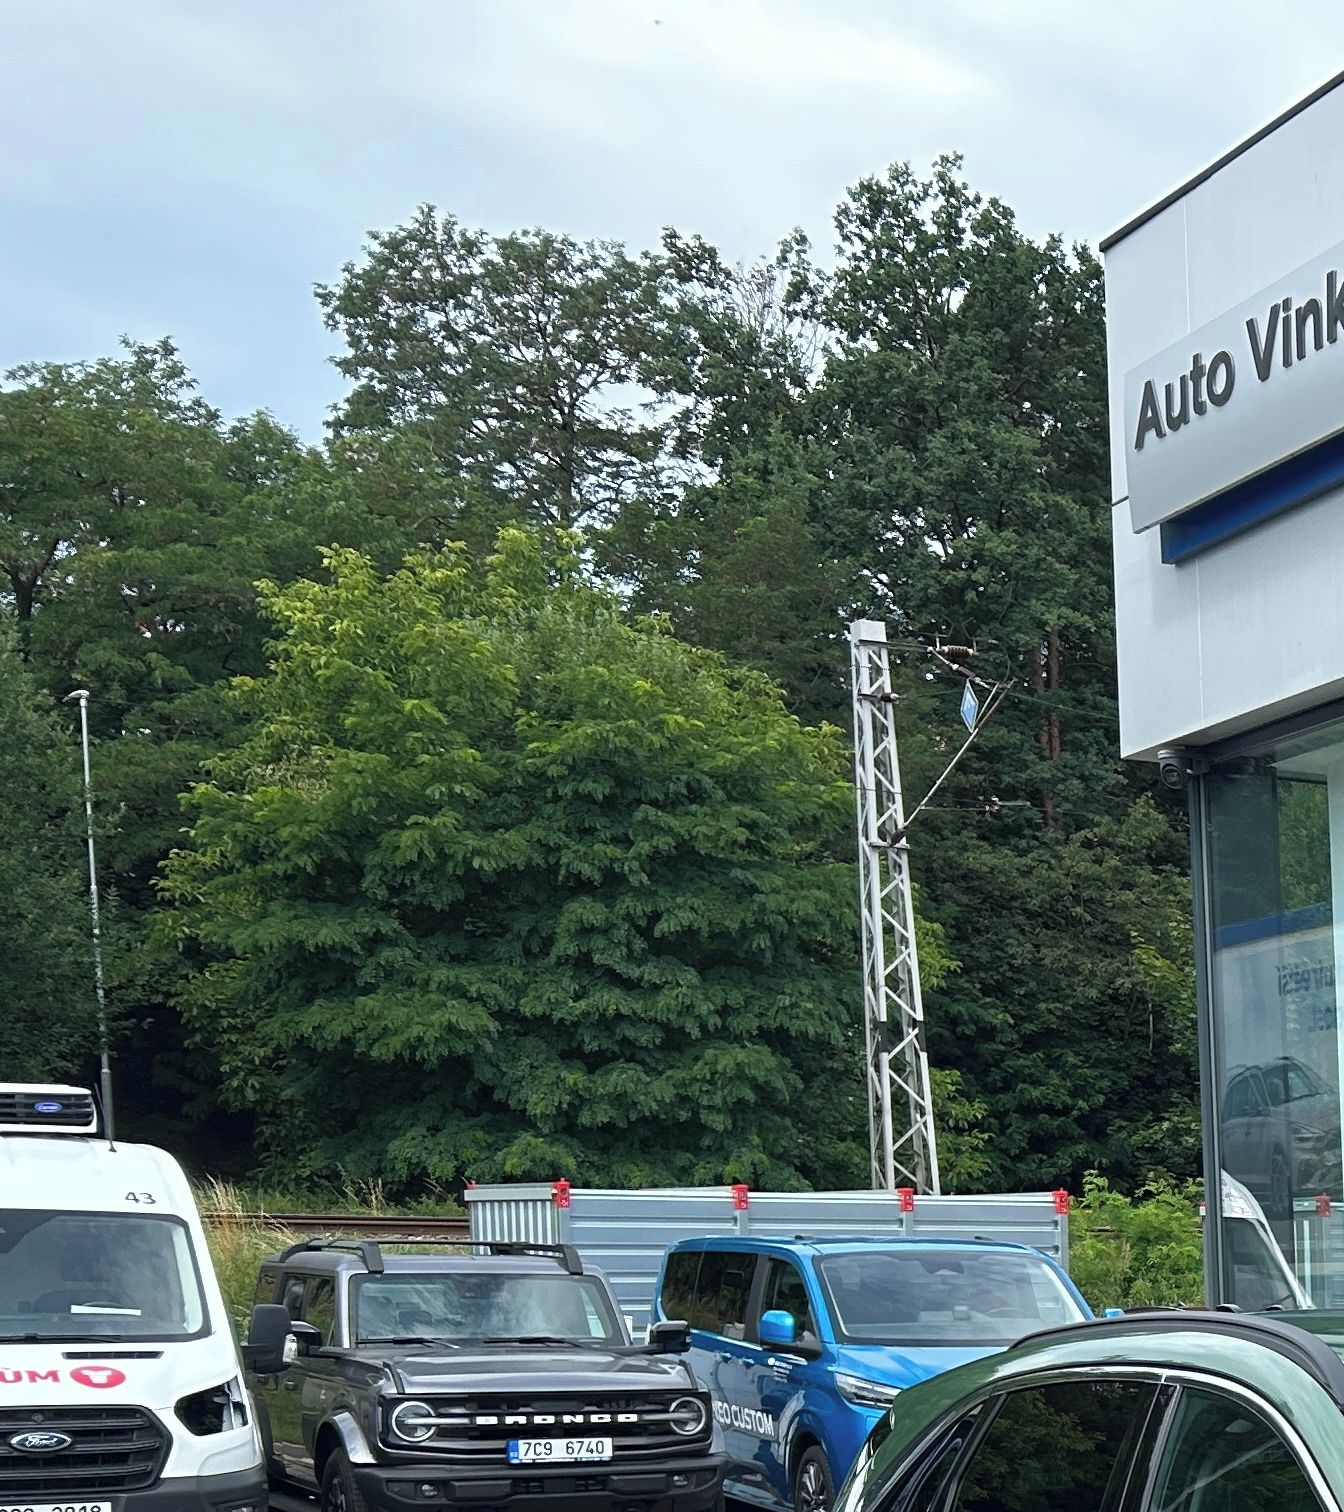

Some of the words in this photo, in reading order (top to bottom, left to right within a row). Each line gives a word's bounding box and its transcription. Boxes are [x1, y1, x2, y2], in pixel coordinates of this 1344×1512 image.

[1134, 350, 1236, 453] Auto
[475, 1413, 638, 1425] BRONCO
[731, 1404, 775, 1437] CUSTOM
[522, 1441, 553, 1457] 7C9
[565, 1440, 605, 1456] 6740
